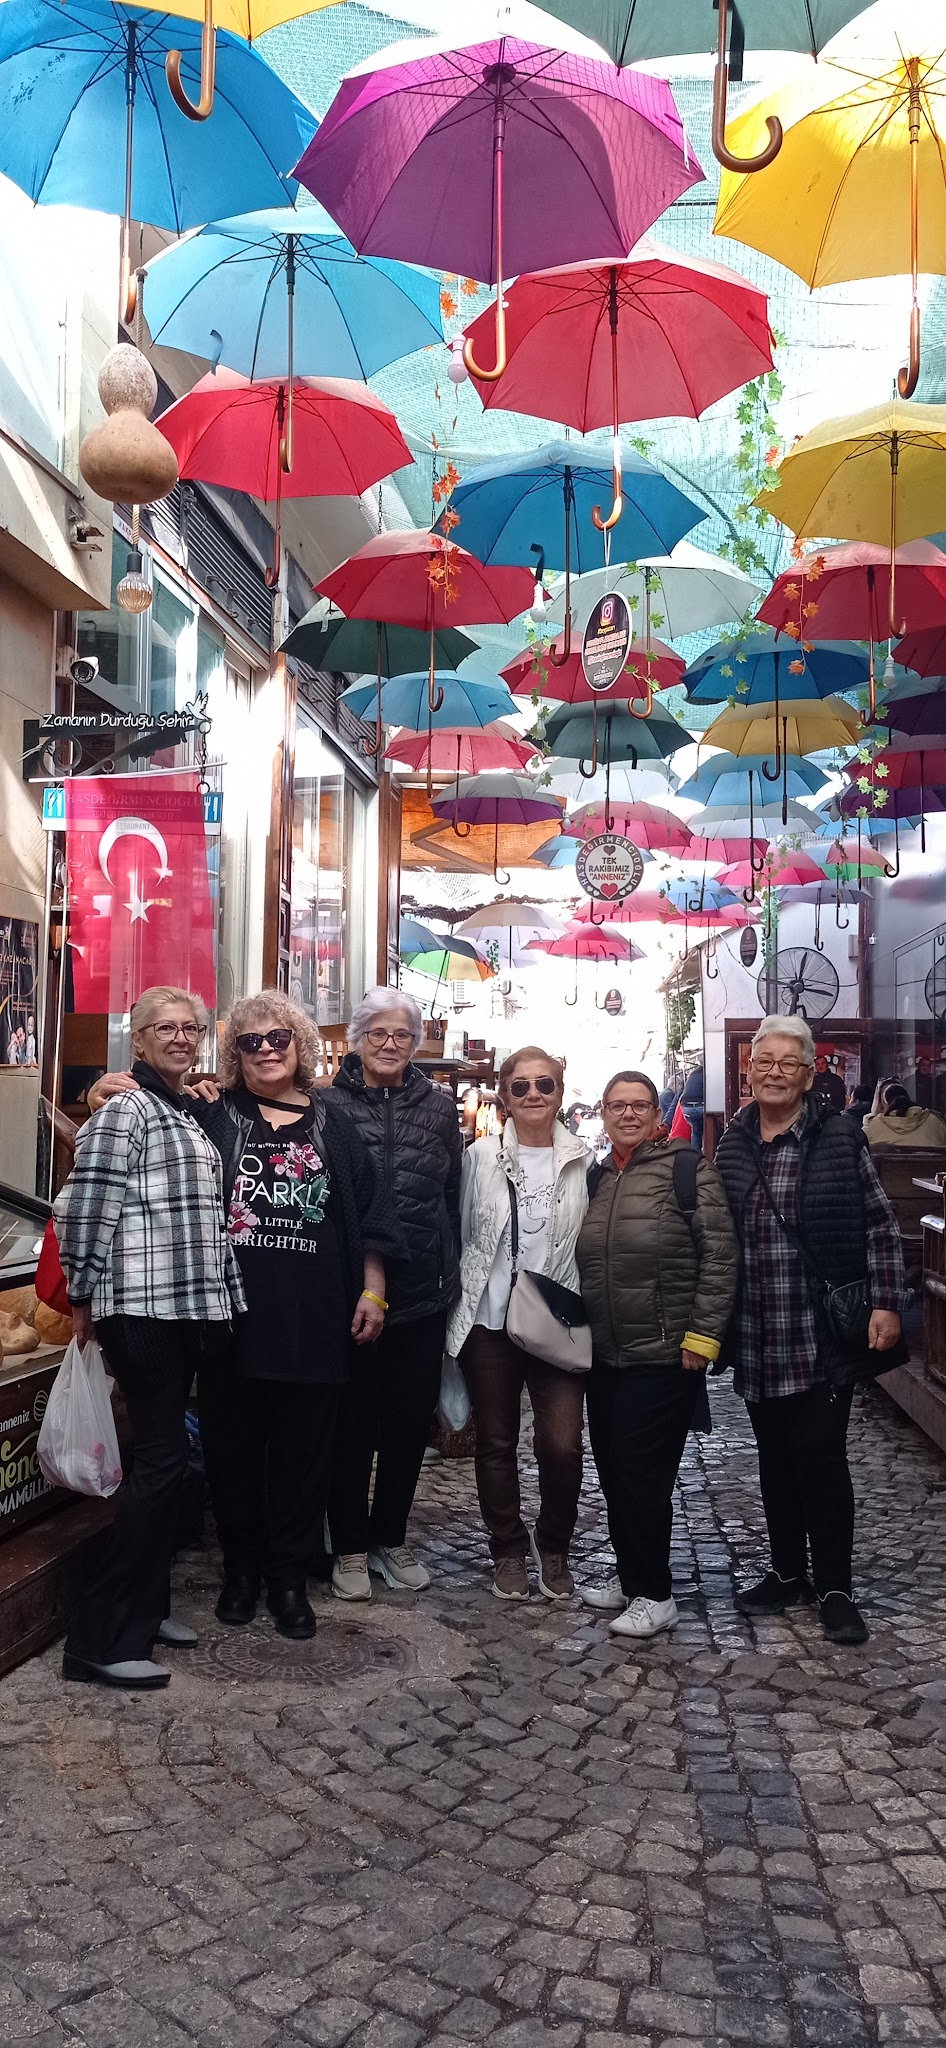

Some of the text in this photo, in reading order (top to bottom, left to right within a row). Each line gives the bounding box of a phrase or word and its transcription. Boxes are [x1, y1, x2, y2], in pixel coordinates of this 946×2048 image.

[42, 712, 193, 731] Zamanın Durduğu Şehir
[588, 865, 630, 873] RAKİBİMİZ
[602, 857, 617, 865] TEK
[238, 1154, 264, 1176] O
[264, 1217, 304, 1230] LITTLE
[234, 1232, 317, 1254] BRIGHTER
